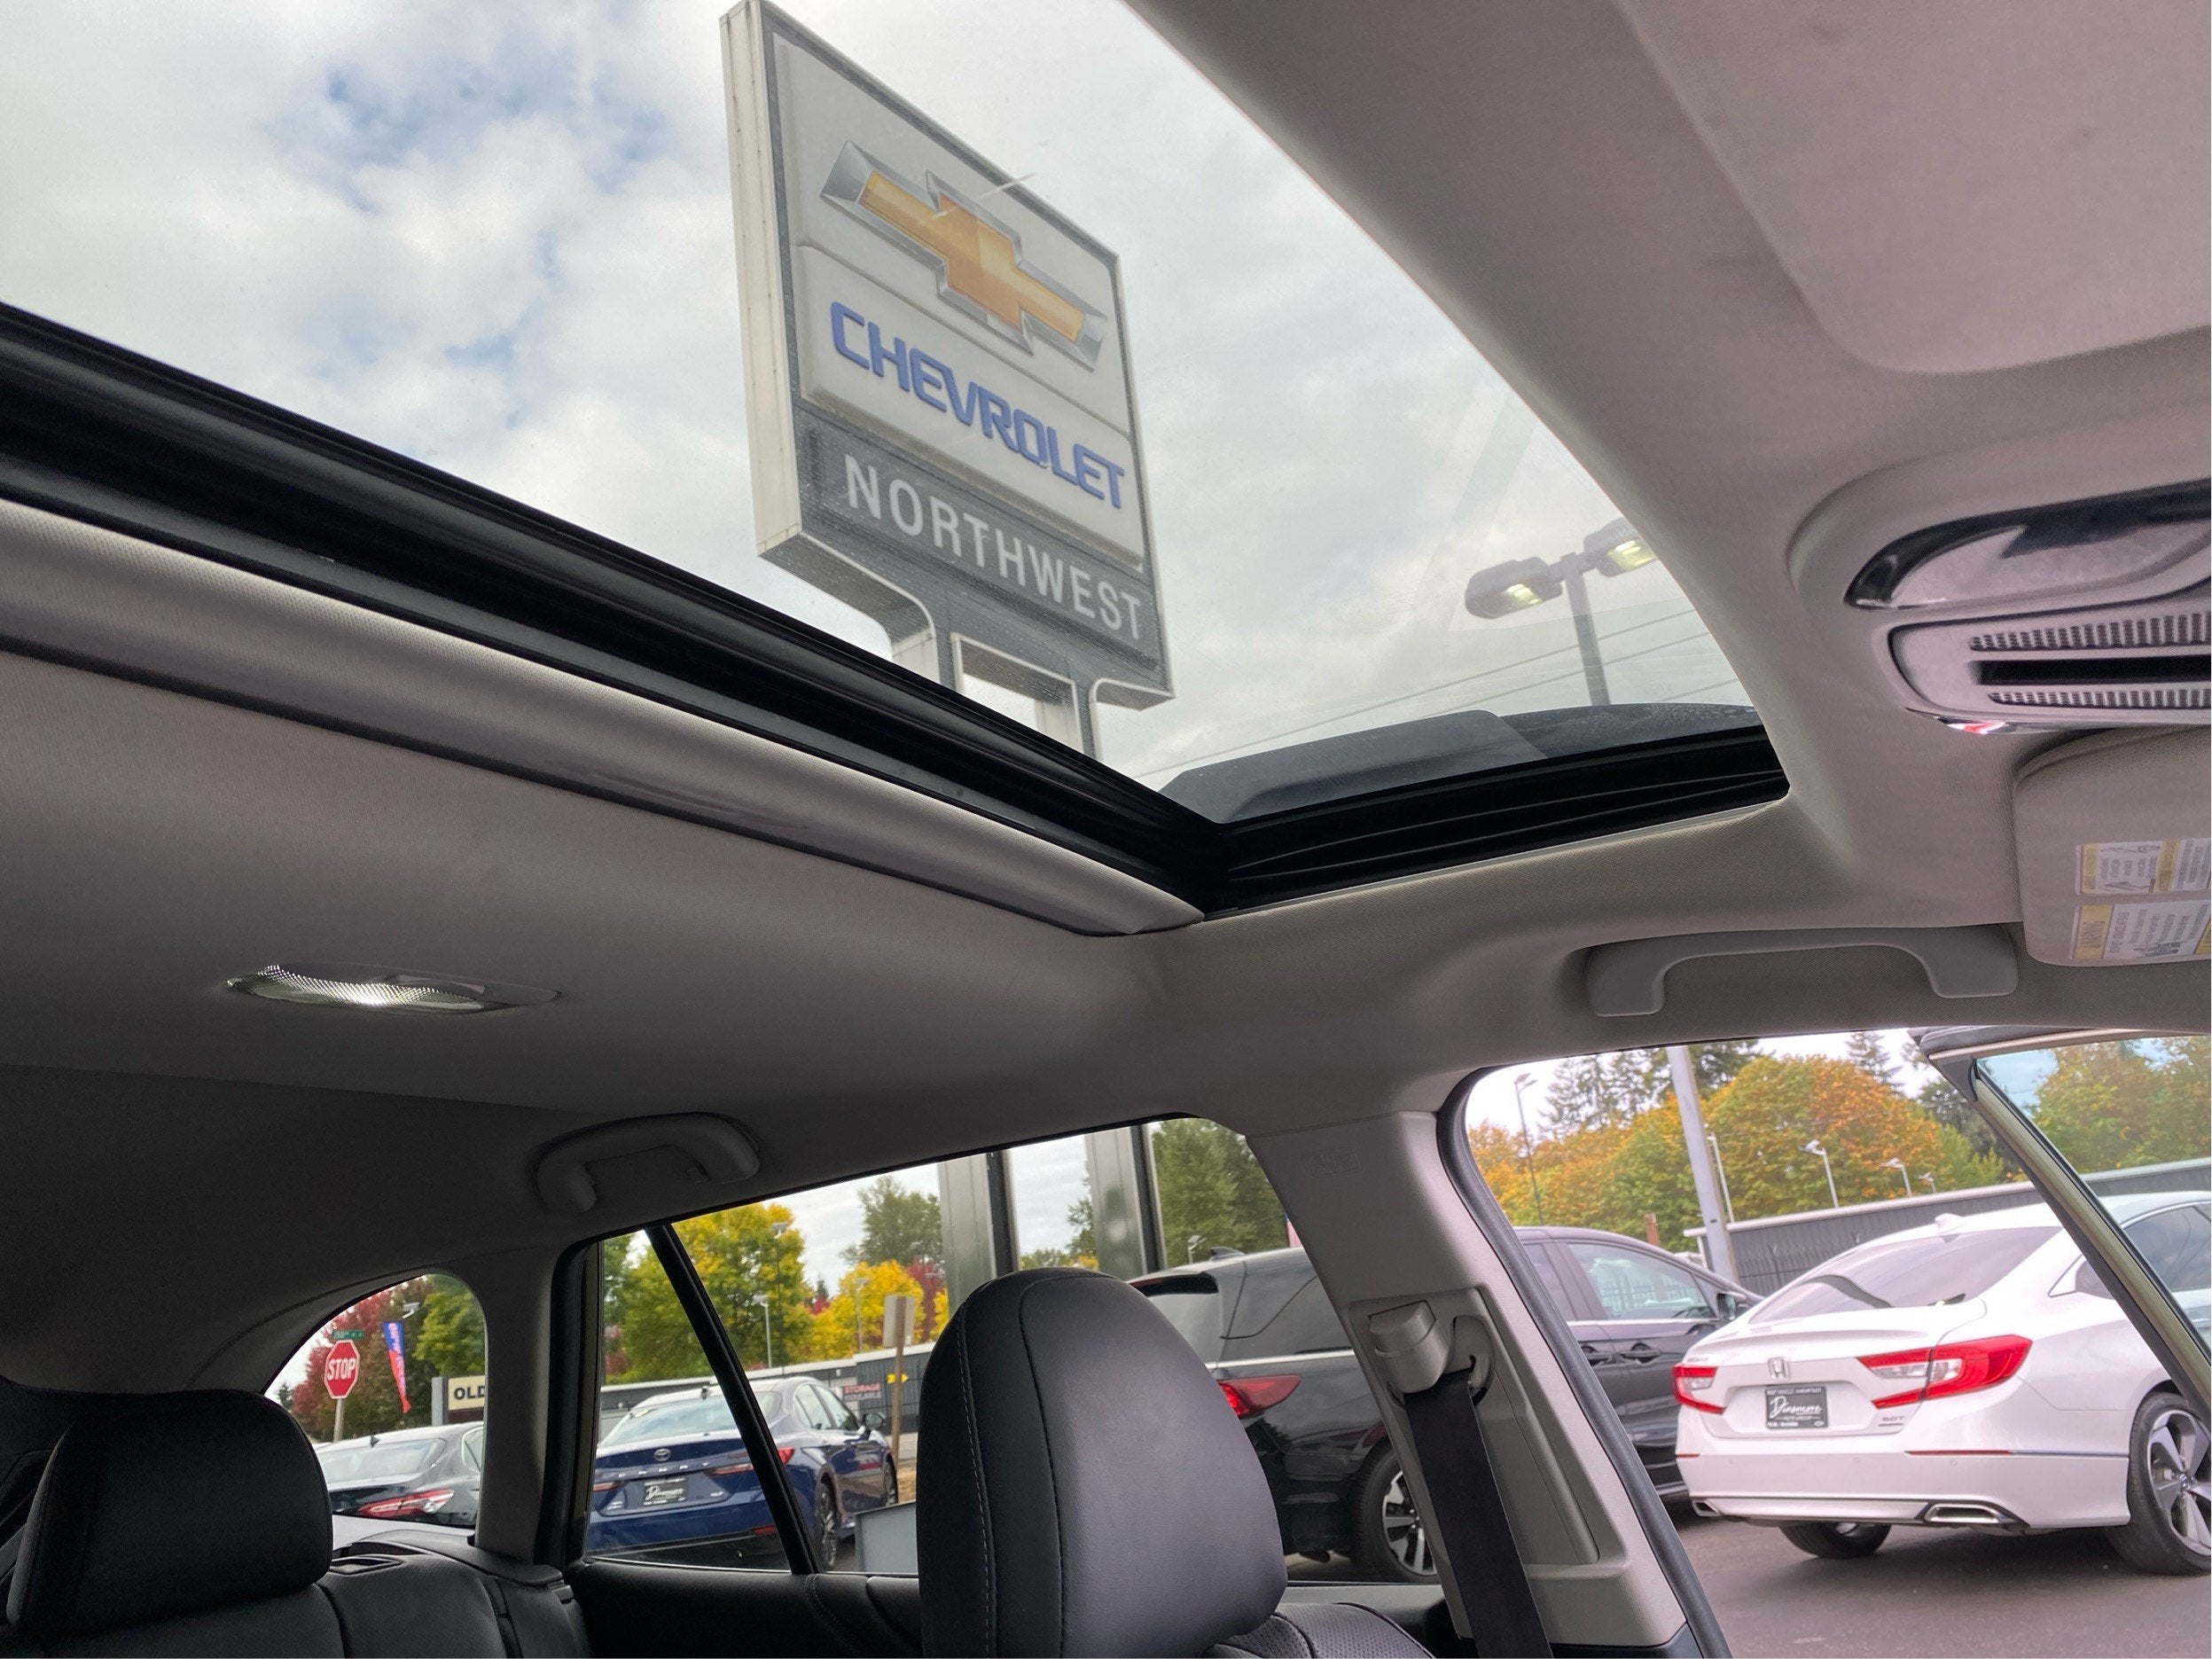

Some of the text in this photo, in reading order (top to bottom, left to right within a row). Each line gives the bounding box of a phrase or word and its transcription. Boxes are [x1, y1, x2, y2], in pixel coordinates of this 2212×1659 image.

[830, 301, 1125, 509] CHEVROLET
[844, 453, 1142, 641] NORTHWEST
[327, 1357, 356, 1381] STOP
